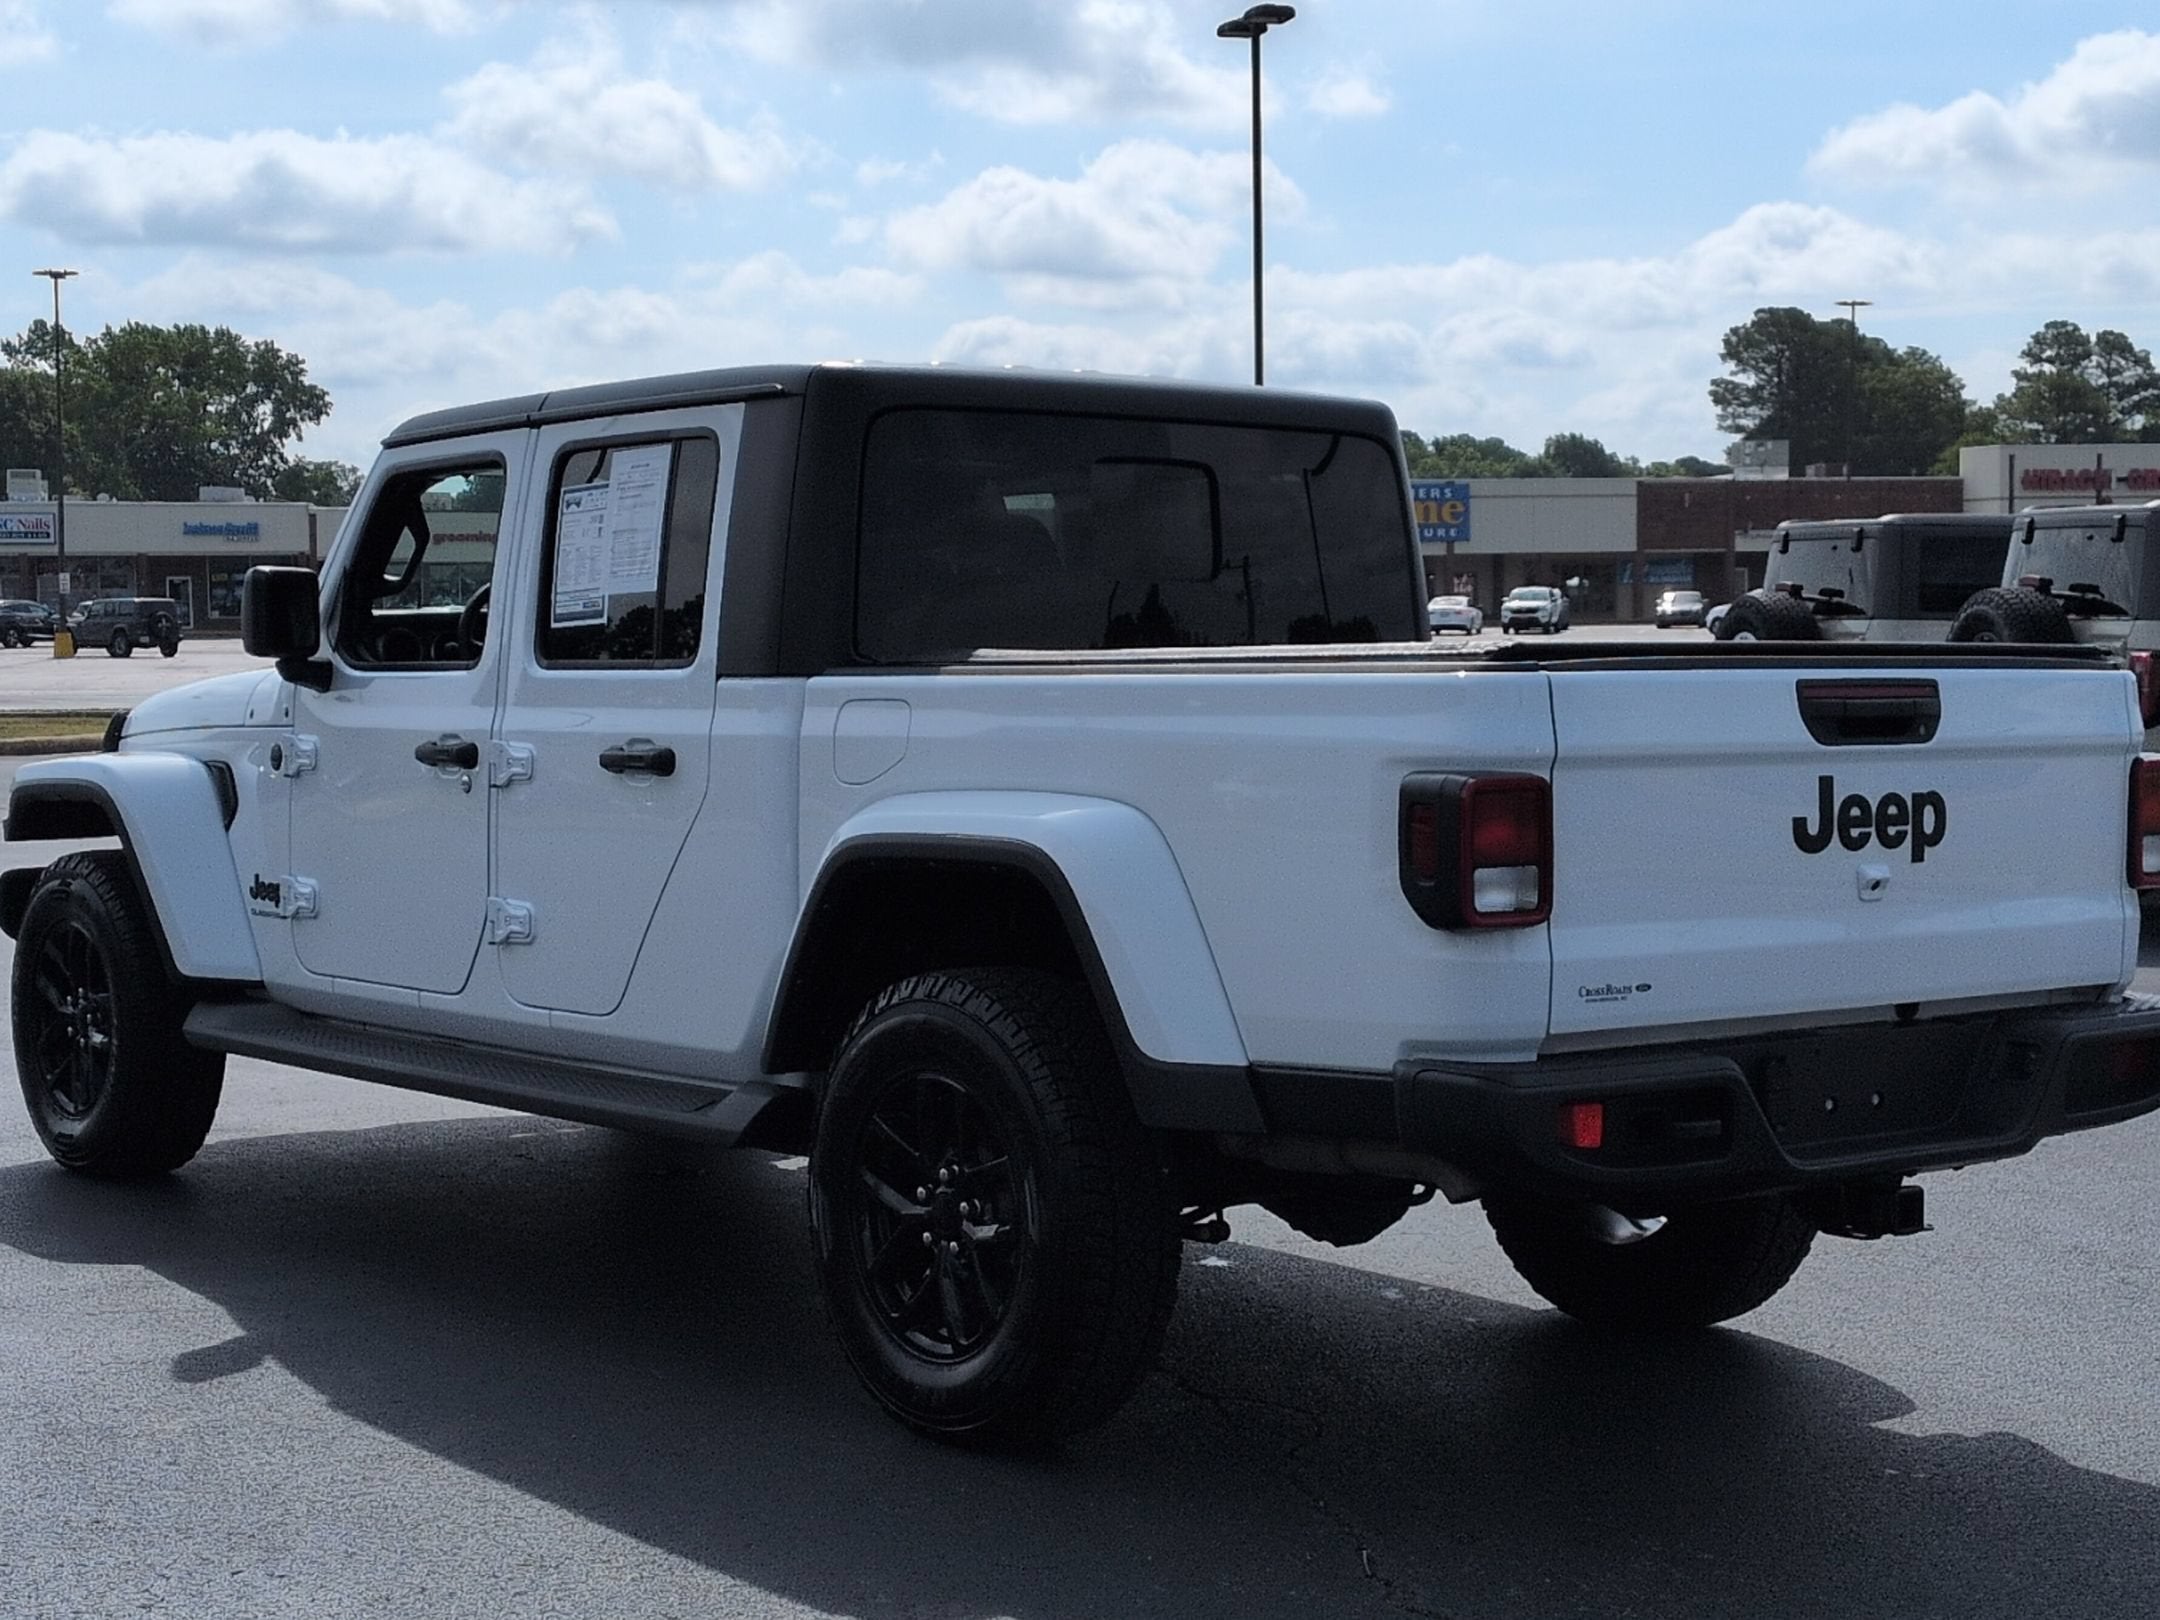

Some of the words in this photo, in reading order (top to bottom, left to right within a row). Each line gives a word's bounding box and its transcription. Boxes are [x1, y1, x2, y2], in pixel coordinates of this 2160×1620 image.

[16, 517, 51, 530] Nails
[1792, 775, 1947, 863] Jeep
[249, 873, 281, 908] Jeep
